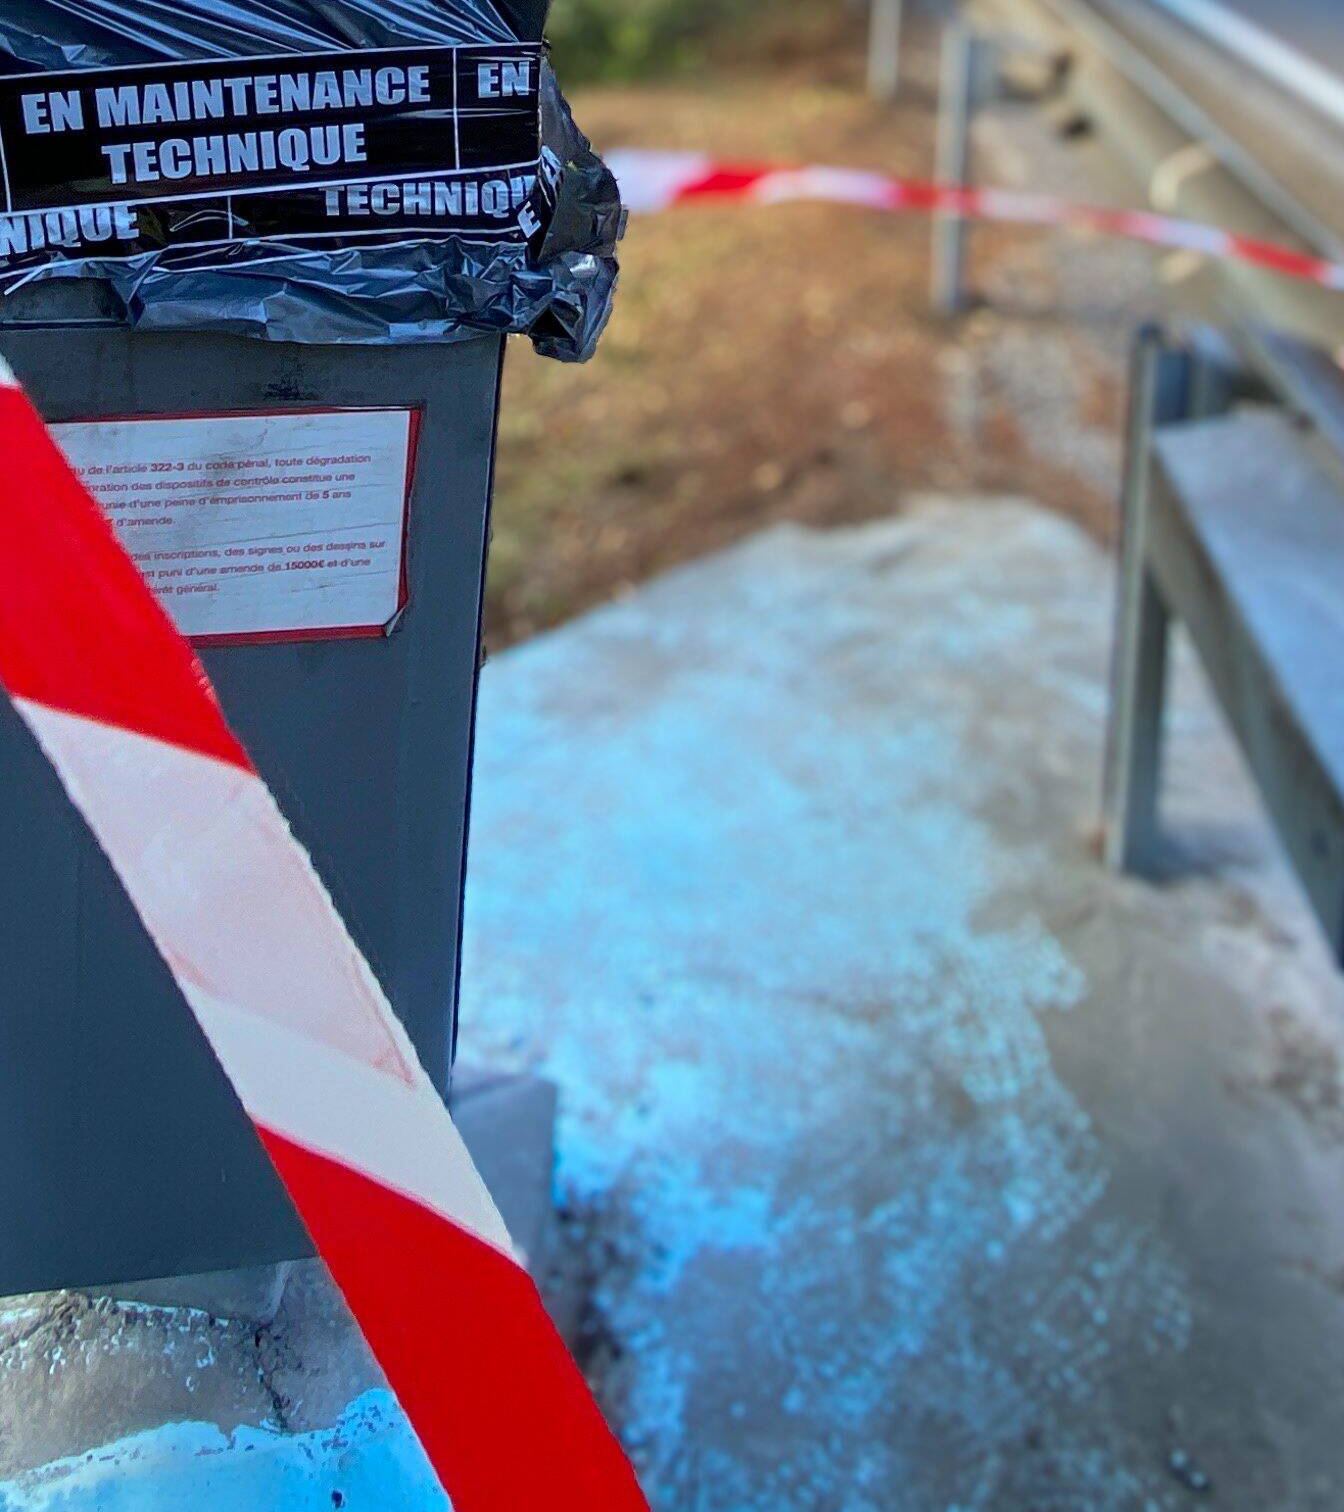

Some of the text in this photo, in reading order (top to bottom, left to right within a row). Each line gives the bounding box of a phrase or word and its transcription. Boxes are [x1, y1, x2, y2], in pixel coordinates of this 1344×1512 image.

[21, 90, 84, 135] EN
[95, 66, 431, 128] MAINTENANCE
[477, 61, 531, 99] EN
[101, 123, 368, 185] TECHNIQUE
[150, 461, 185, 473] 322-3
[187, 461, 203, 472] du
[237, 458, 271, 470] pénal,
[275, 456, 303, 467] toute
[305, 454, 372, 468] dégradation
[131, 481, 152, 491] des
[155, 478, 214, 491] dispositifs
[216, 477, 230, 487] de
[234, 475, 279, 486] contrôle
[281, 473, 333, 484] constitue
[335, 472, 356, 482] une
[164, 498, 196, 509] peine
[199, 492, 302, 506] d'emprisonnement
[322, 490, 330, 500] 5
[332, 490, 352, 500] ans
[154, 549, 221, 561] inscriptions,
[224, 547, 245, 557] des
[248, 546, 284, 558] signes
[286, 545, 301, 554] ou
[303, 543, 324, 553] des
[325, 541, 367, 552] dessins
[369, 540, 386, 550] sur
[158, 567, 182, 579] puni
[219, 564, 264, 575] amende
[267, 563, 282, 573] de
[286, 559, 325, 570] 15000€
[340, 557, 372, 568] d'une
[176, 583, 221, 596] général.
